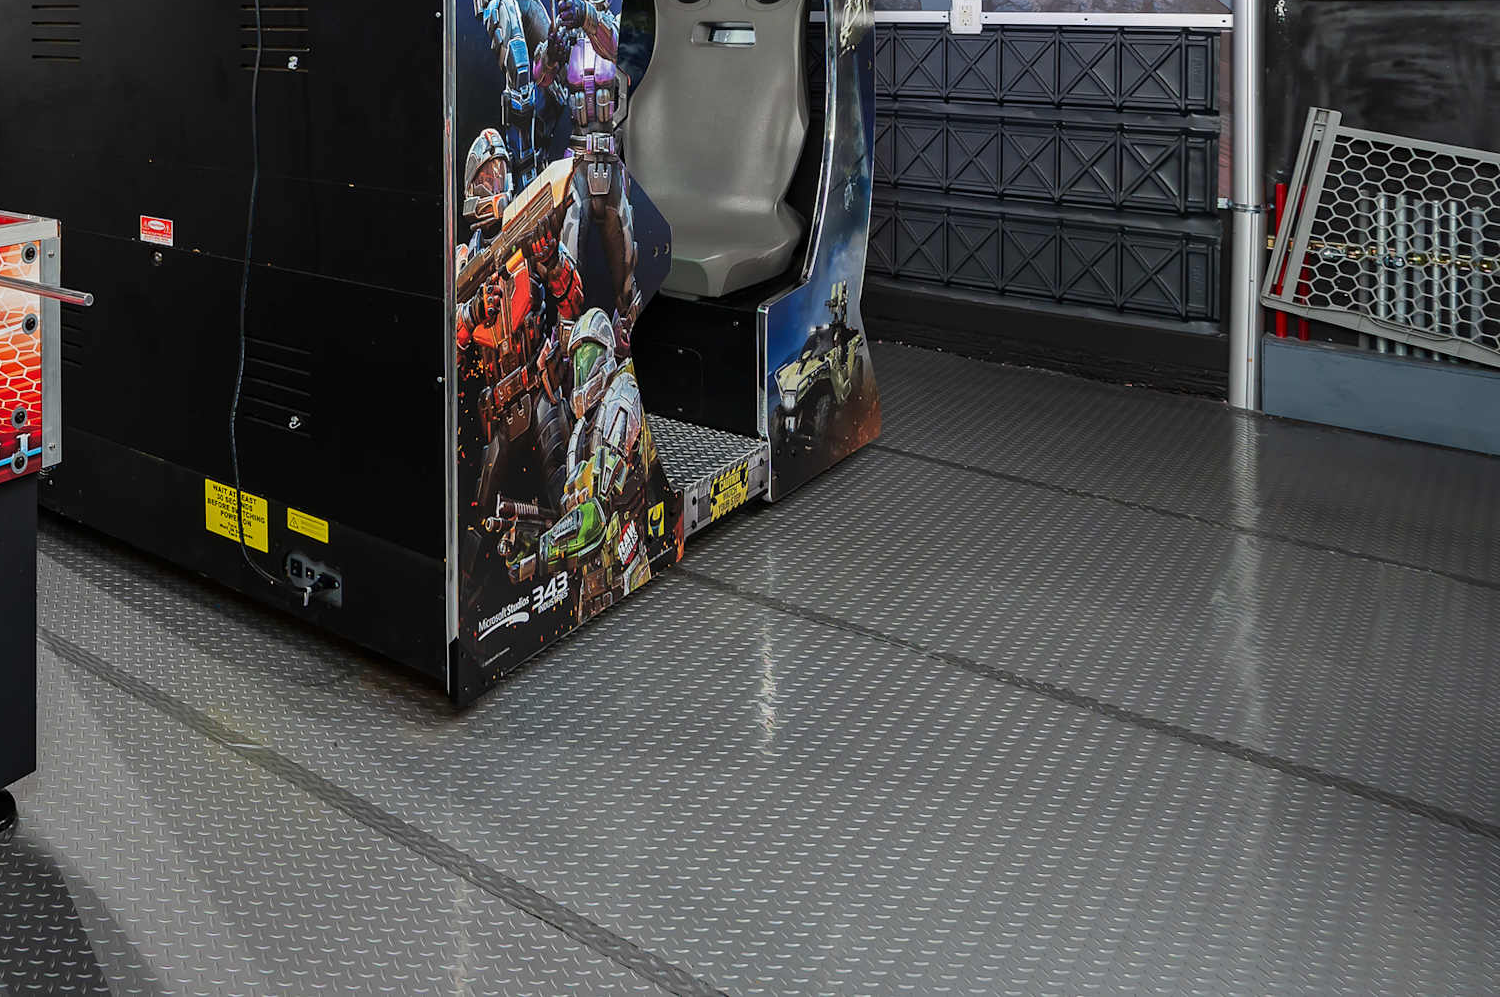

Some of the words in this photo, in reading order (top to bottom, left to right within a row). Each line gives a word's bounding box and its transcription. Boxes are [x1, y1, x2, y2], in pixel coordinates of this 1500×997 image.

[207, 497, 230, 511] BEFORE
[212, 484, 228, 496] WAIT
[240, 494, 257, 505] EAST
[220, 510, 239, 522] POWE
[531, 571, 568, 610] 343
[538, 588, 569, 614] INDUSTRIES
[478, 606, 507, 633] Microsoft
[506, 595, 530, 616] Studios
